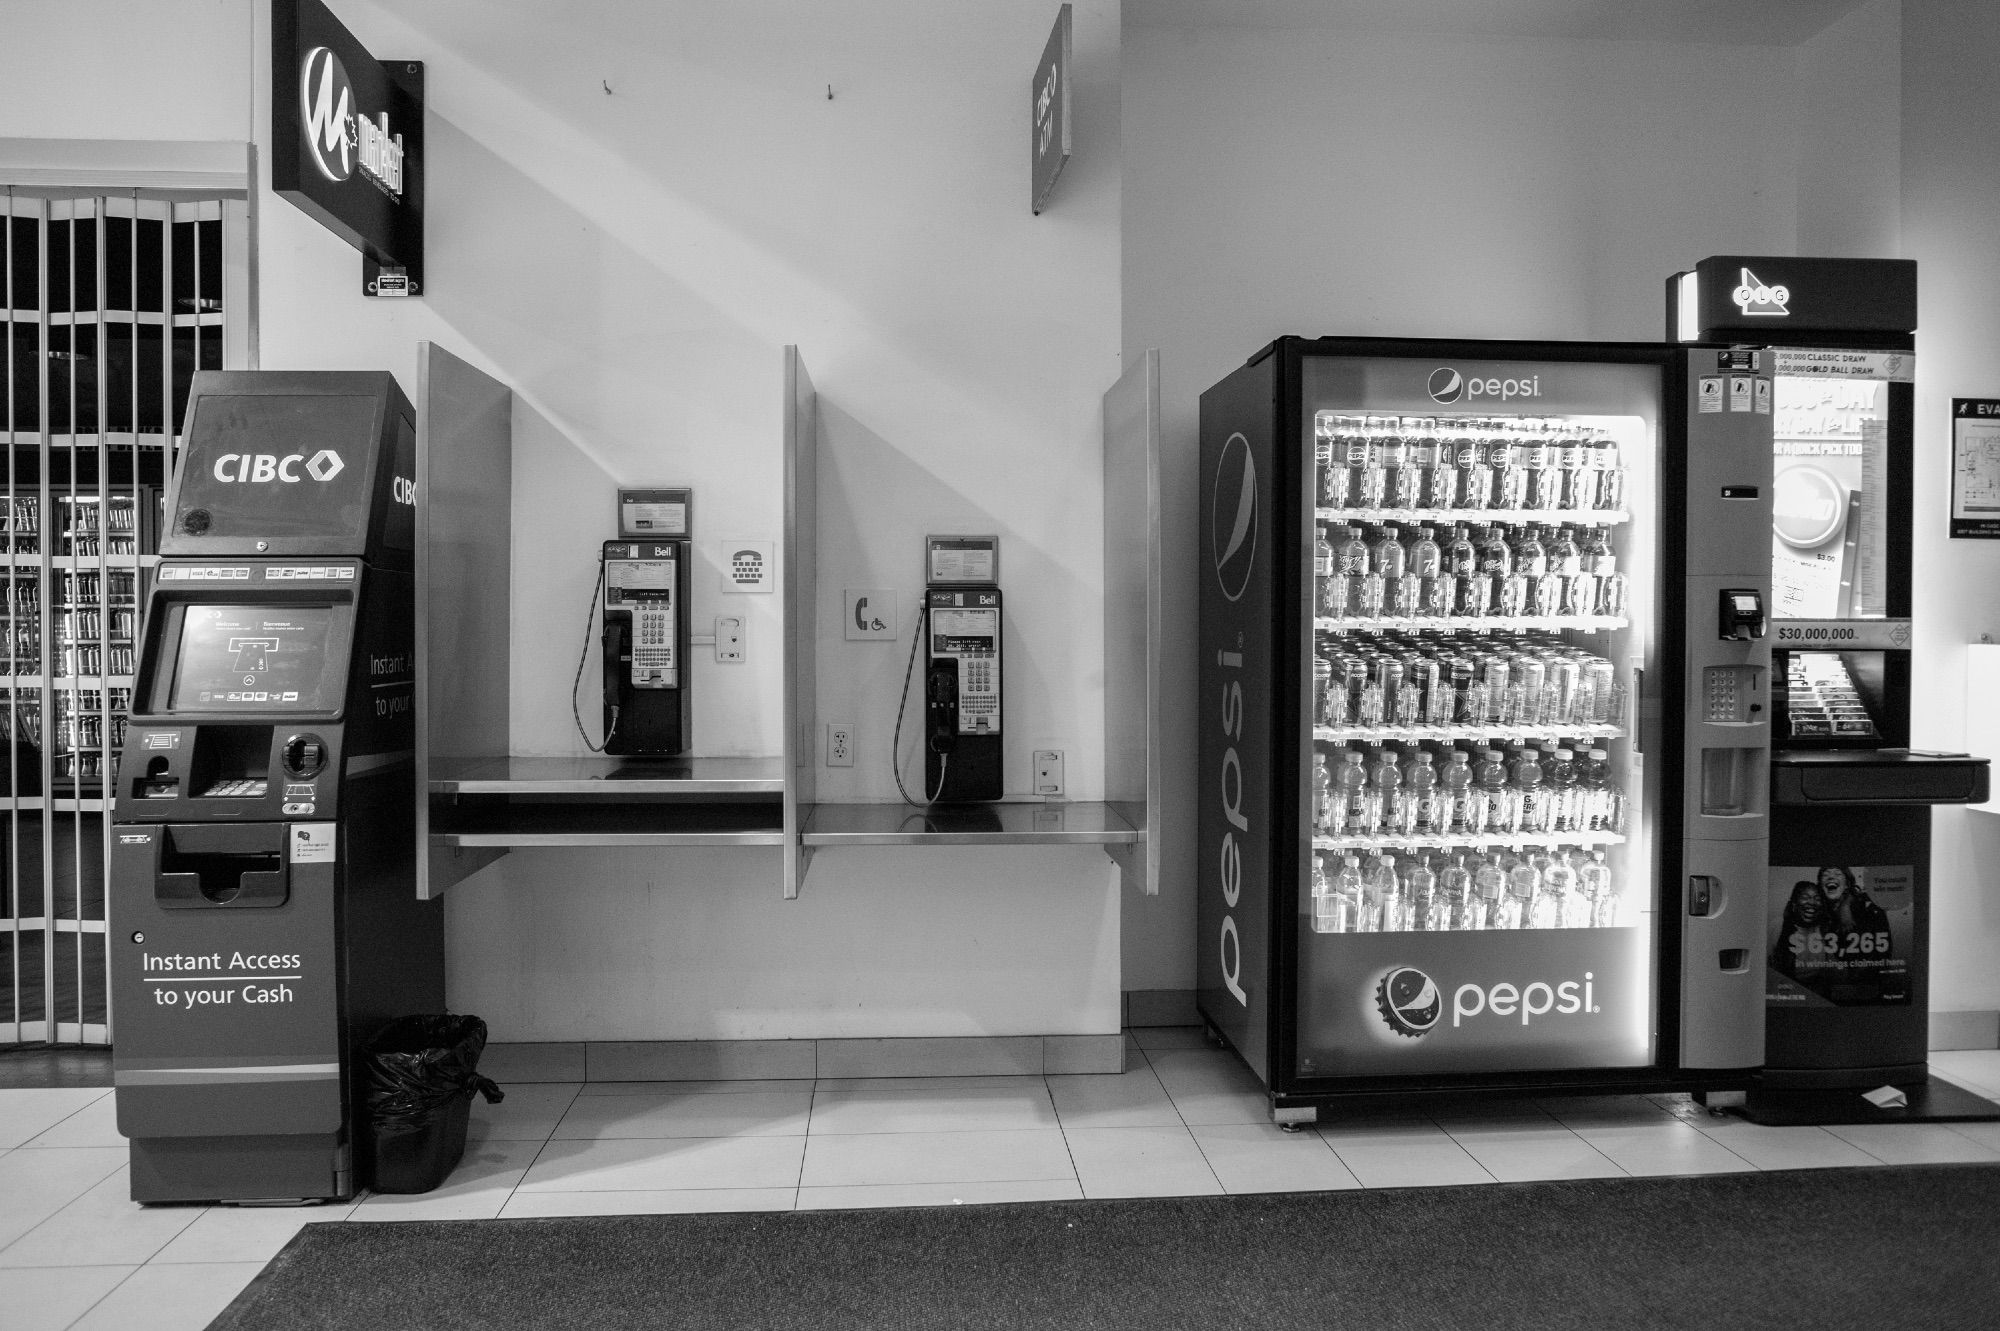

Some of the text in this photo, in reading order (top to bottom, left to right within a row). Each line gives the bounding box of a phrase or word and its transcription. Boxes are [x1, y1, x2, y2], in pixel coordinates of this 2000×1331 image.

[1807, 353, 1840, 362] CLASSIC
[1842, 355, 1866, 363] DRAW
[1831, 366, 1849, 374] BALL
[1852, 366, 1875, 375] DRAW
[1468, 375, 1539, 401] pepsi
[213, 453, 304, 483] CIBC
[654, 546, 671, 556] Bell
[979, 595, 996, 605] Bell
[1778, 627, 1854, 641] $30,000,000
[370, 652, 405, 675] Instant
[375, 695, 409, 720] to your
[1218, 648, 1248, 1008] pepsi
[1788, 931, 1889, 958] $63,265
[143, 951, 301, 971] Instant Access
[1795, 960, 1804, 968] in
[1806, 959, 1848, 970] winnings
[1849, 958, 1885, 968] claimed
[153, 983, 294, 1009] to your Cash
[1453, 971, 1594, 1028] pepsi
